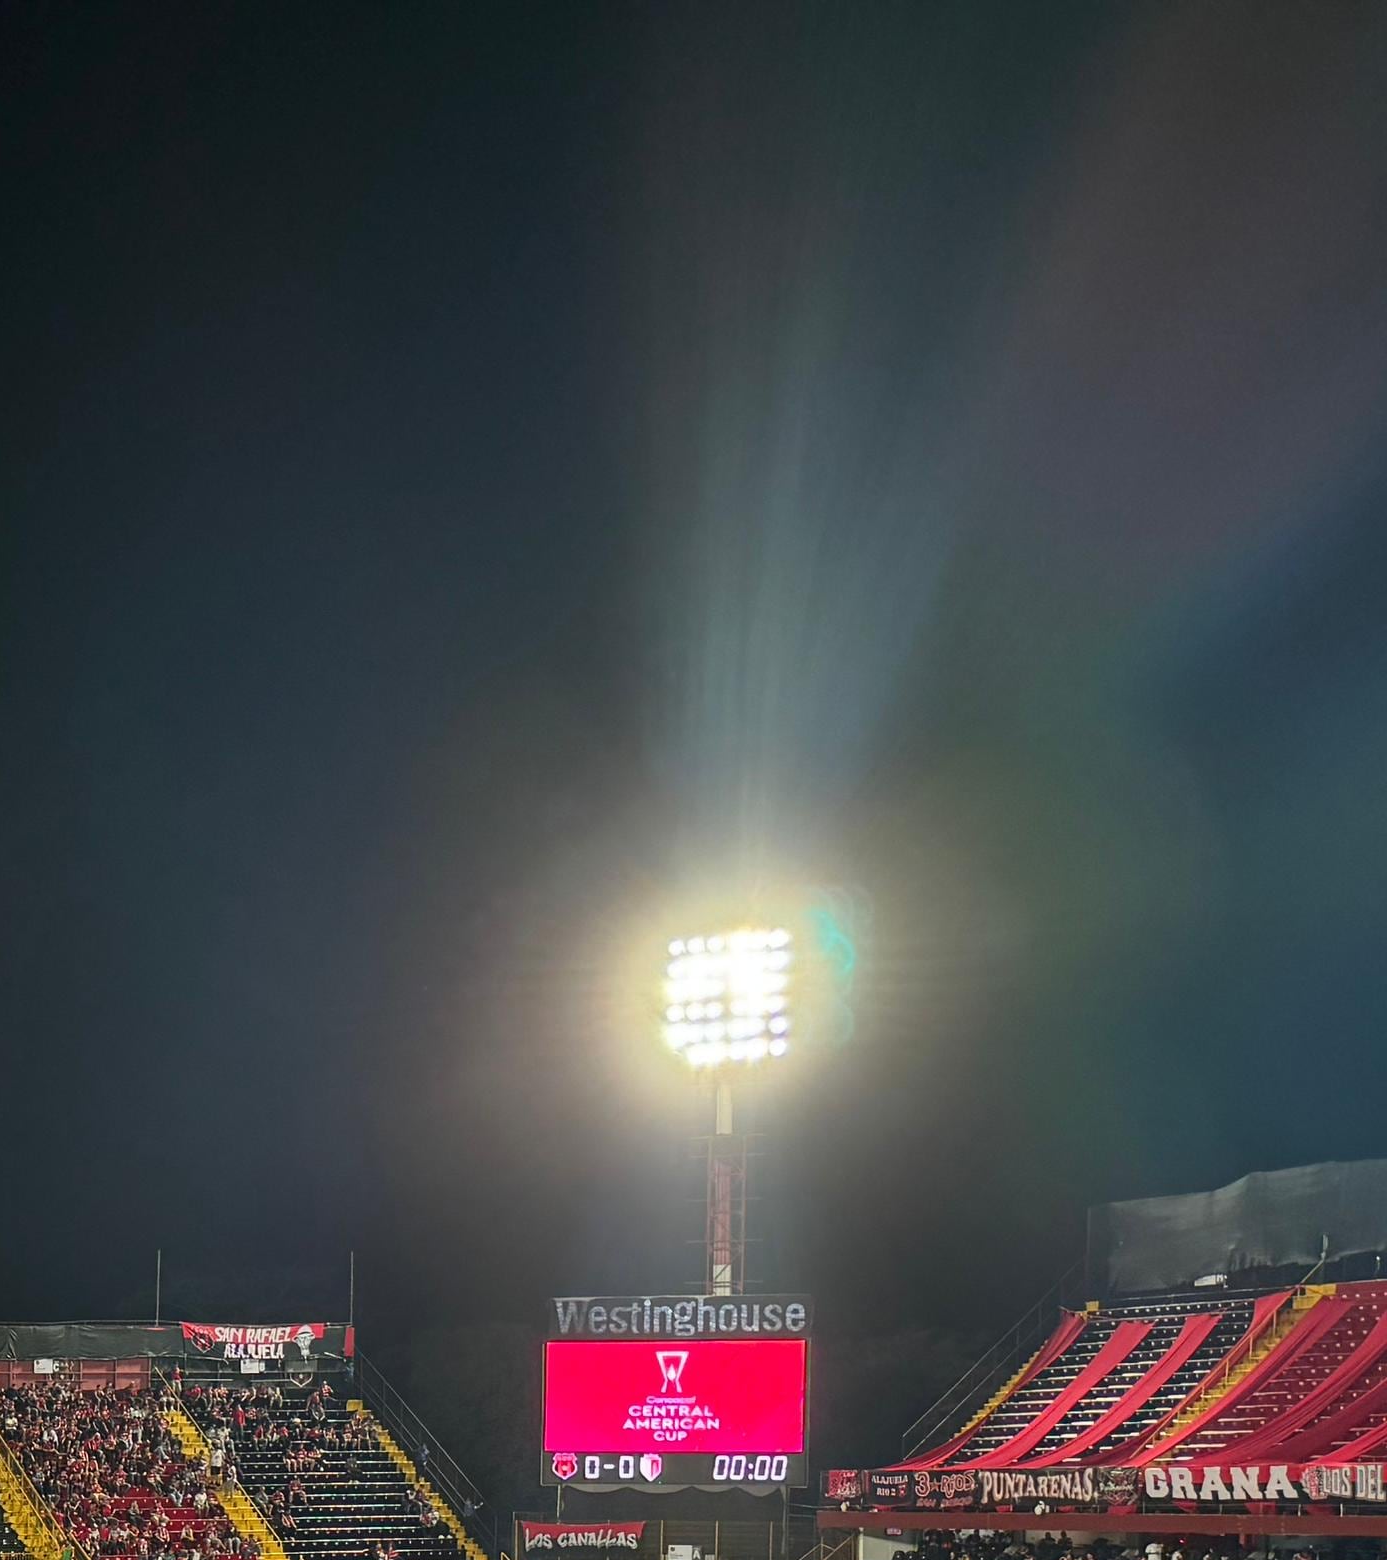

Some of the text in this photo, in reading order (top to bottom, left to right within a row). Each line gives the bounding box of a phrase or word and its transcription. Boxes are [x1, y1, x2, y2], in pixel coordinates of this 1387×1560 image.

[555, 1299, 806, 1336] Westinghouse
[214, 1326, 293, 1344] SAN RAFAEL
[622, 1417, 720, 1430] AMERICAN
[628, 1405, 714, 1417] CENTRAL
[653, 1431, 688, 1442] CUP
[713, 1455, 788, 1481] 00:00
[982, 1469, 1094, 1504] PUNTARENAS
[1144, 1465, 1299, 1500] GRANA
[525, 1527, 638, 1552] LOS CANALLAS
